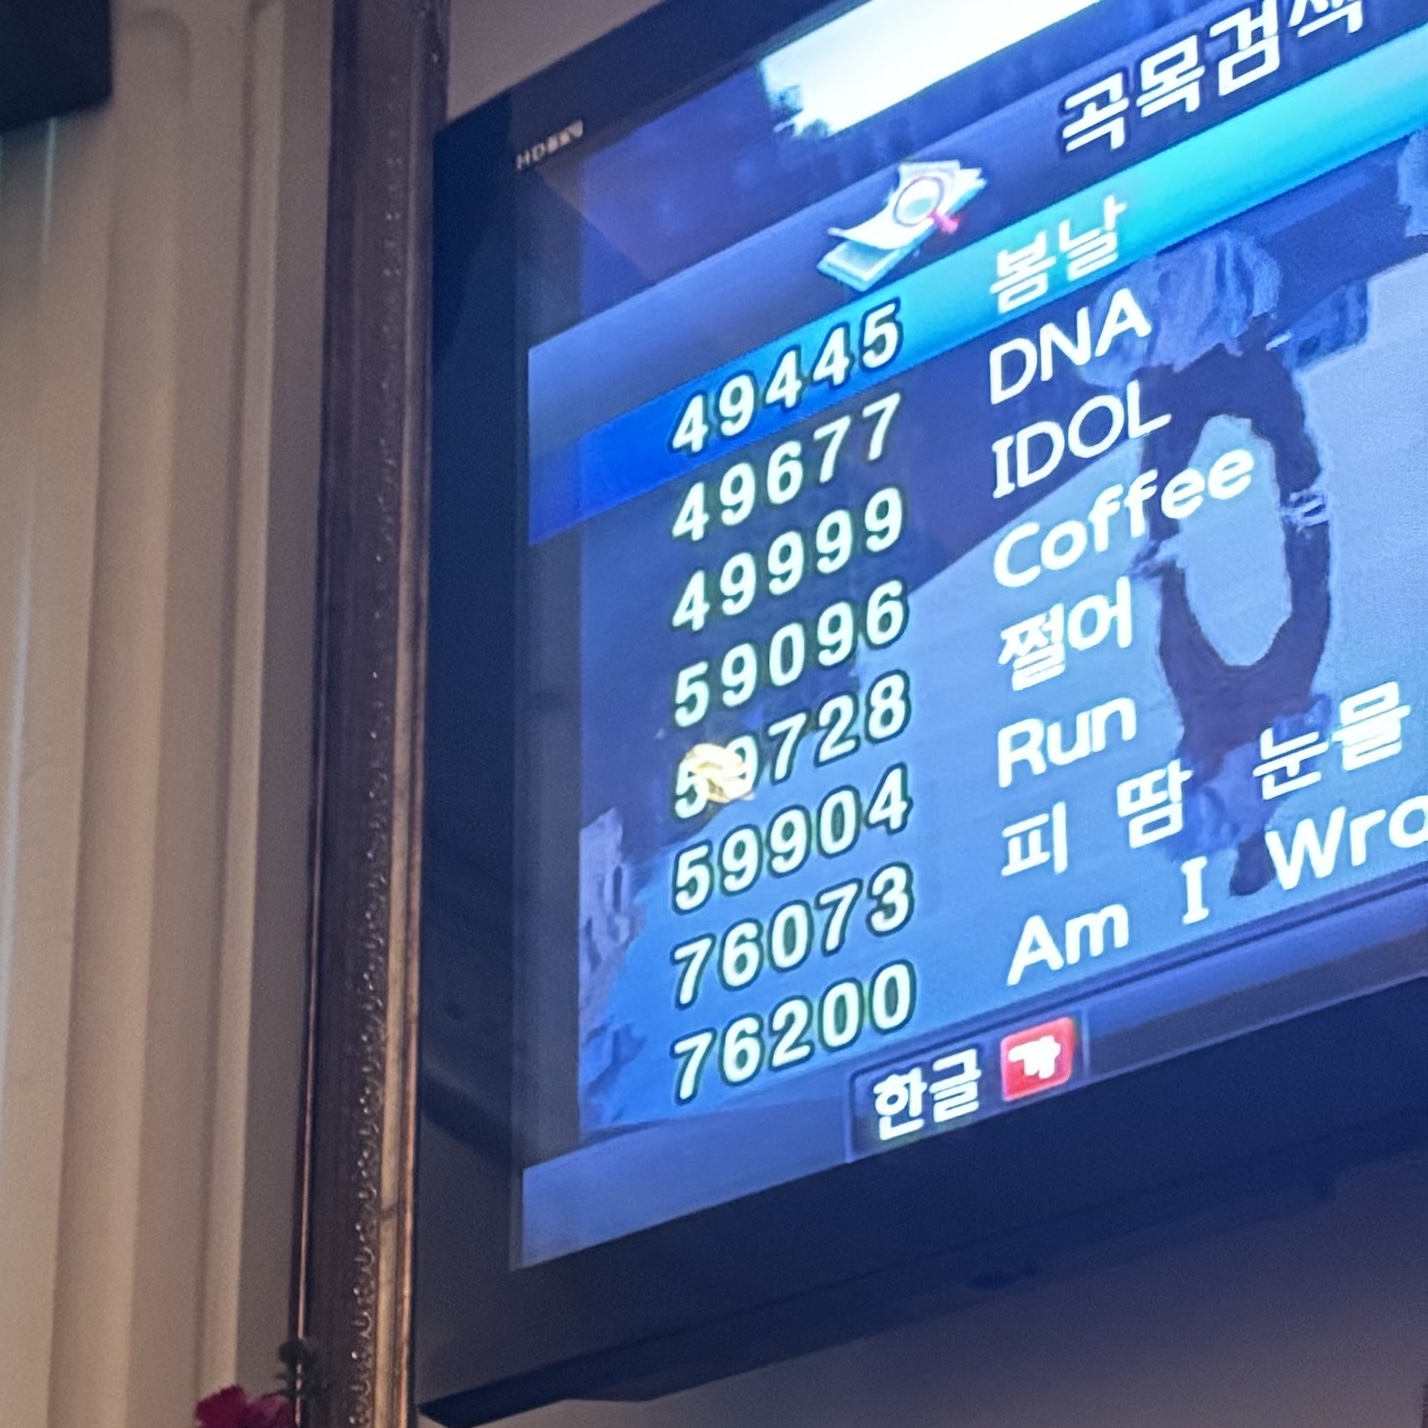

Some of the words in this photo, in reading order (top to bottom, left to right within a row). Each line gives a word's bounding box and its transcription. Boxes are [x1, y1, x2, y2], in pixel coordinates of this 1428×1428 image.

[672, 303, 901, 453] 49445
[989, 194, 1128, 314] 봄날
[672, 392, 902, 542] 49677
[989, 287, 1153, 405] DNA
[672, 487, 904, 630] 49999
[991, 380, 1173, 499] IDOL
[674, 579, 905, 728] 59096
[992, 448, 1255, 588] Coffee
[997, 575, 1133, 692] 쩔어
[674, 865, 910, 1005] 76073
[1000, 800, 1069, 877] 피
[1116, 758, 1194, 849] 땀
[1252, 681, 1412, 801] 눈물
[675, 767, 909, 910] 59904
[996, 696, 1138, 789] Run
[674, 963, 912, 1100] 76200
[1006, 902, 1130, 986] Am
[1179, 855, 1211, 926] I
[872, 1047, 983, 1142] 한글
